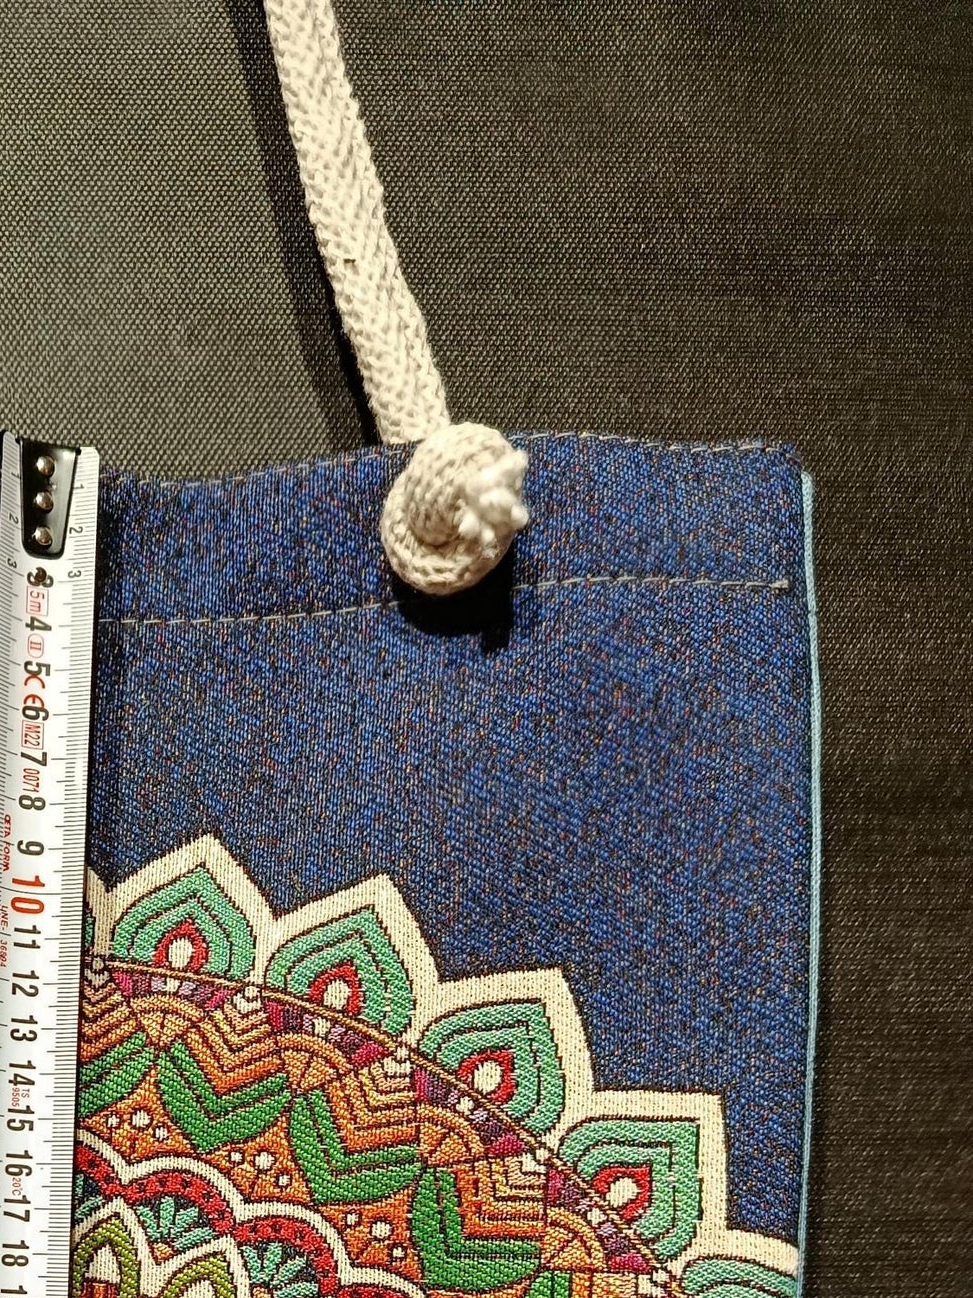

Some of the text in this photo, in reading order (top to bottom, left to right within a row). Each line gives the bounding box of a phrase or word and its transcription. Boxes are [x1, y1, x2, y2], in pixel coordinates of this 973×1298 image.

[9, 513, 19, 524] 2
[69, 526, 83, 535] 2
[7, 558, 17, 569] 3
[67, 570, 82, 578] 3
[25, 616, 52, 632] 4
[24, 660, 51, 677] 5
[22, 705, 50, 721] 6
[24, 723, 41, 747] M22
[20, 751, 48, 767] 7
[22, 767, 40, 793] 0071
[18, 794, 46, 811] 8
[17, 840, 45, 856] 9
[11, 876, 45, 914] 10
[14, 925, 41, 948] 11
[12, 971, 39, 997] 12
[10, 1015, 38, 1041] 13
[9, 1060, 36, 1086] 14
[11, 1087, 20, 1107] 9505
[7, 1105, 34, 1131] 15
[5, 1150, 33, 1176] 16
[4, 1195, 31, 1222] 17
[2, 1240, 29, 1266] 18
